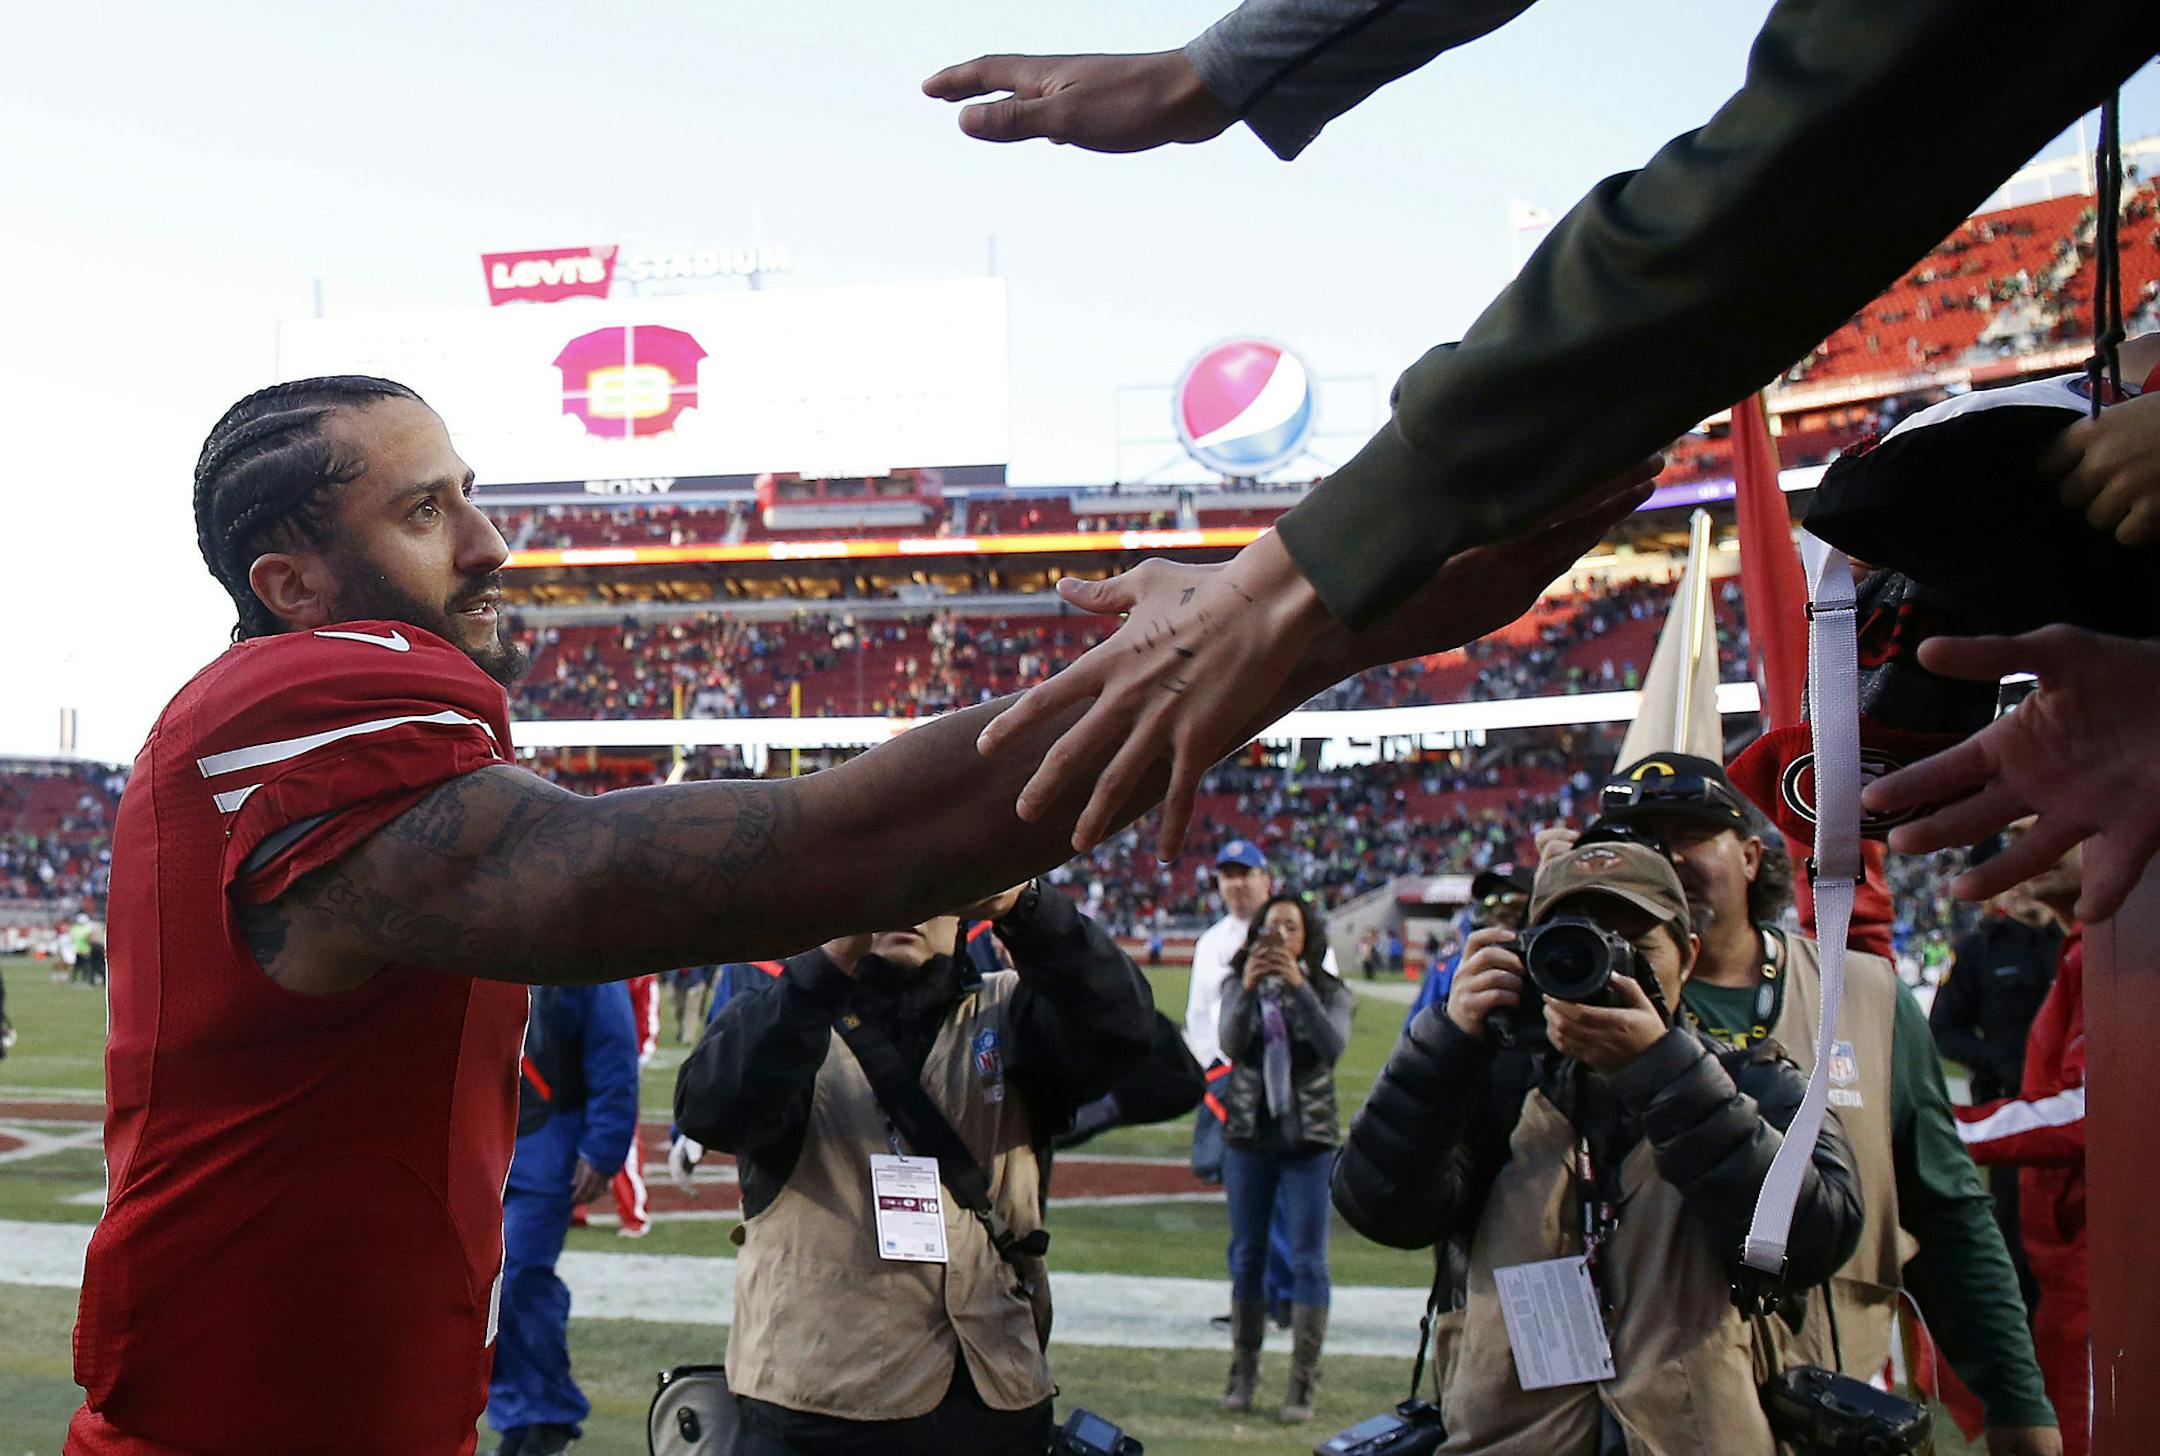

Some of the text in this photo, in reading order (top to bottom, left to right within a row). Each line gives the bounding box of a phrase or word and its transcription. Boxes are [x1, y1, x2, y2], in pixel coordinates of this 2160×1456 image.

[630, 246, 790, 280] STADIUM
[584, 478, 675, 495] SONY
[922, 1201, 938, 1213] 10
